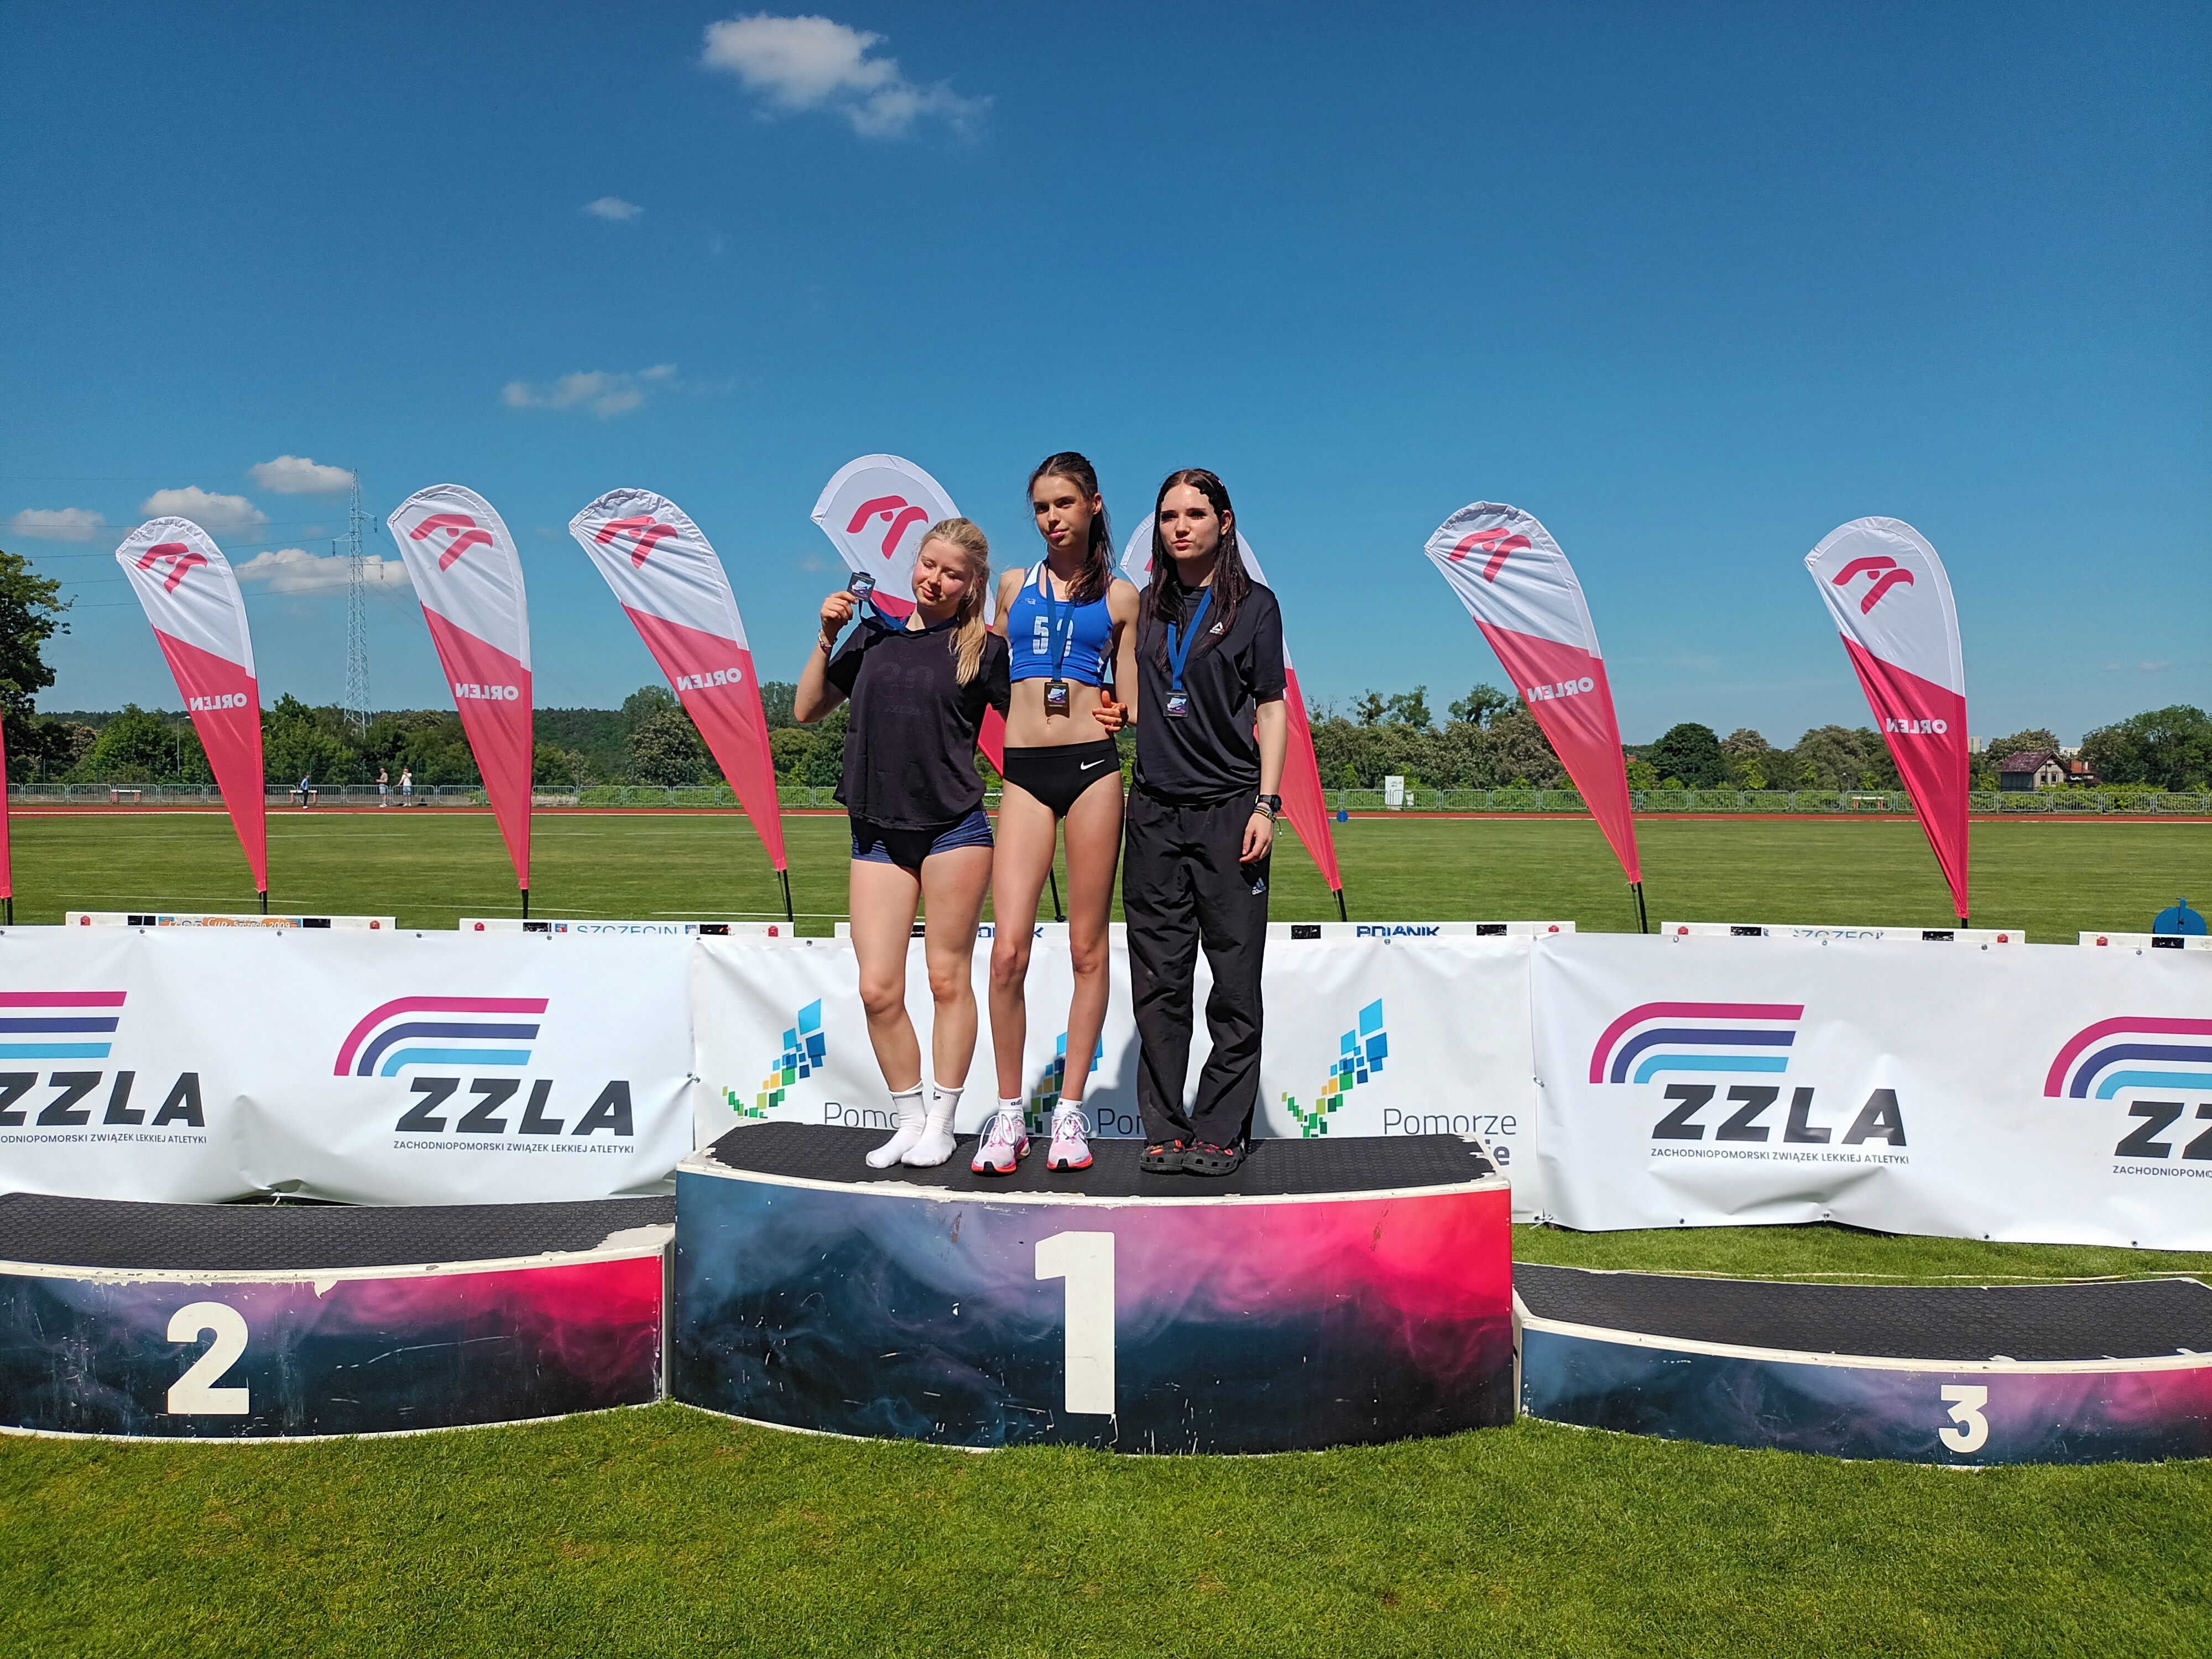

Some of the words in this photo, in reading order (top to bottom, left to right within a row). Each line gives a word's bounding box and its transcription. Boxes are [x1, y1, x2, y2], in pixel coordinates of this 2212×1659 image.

[395, 1077, 634, 1136] ZZLA
[1384, 1108, 1516, 1135] Pomorze
[1651, 1084, 1907, 1146] ZZLA
[90, 1134, 134, 1143] ZWIĄZEK
[136, 1134, 166, 1143] LEKKIEJ
[168, 1135, 207, 1144] ATLETYKI
[393, 1141, 504, 1151] ZACHODNIOPOMORSKI
[507, 1143, 549, 1154] ZWIĄZEK
[551, 1144, 587, 1152] LEKKIEJ
[589, 1145, 634, 1154] ATLETYKI
[1651, 1148, 1770, 1160] ZACHODNIOPOMORSKI
[1772, 1152, 1818, 1162] ZWIĄZEK
[1822, 1154, 1861, 1162] LEKKIEJ
[1864, 1155, 1909, 1164] ATLETYKI
[1035, 1231, 1115, 1415] 1
[167, 1301, 250, 1415] 2
[1938, 1384, 1989, 1454] 3
